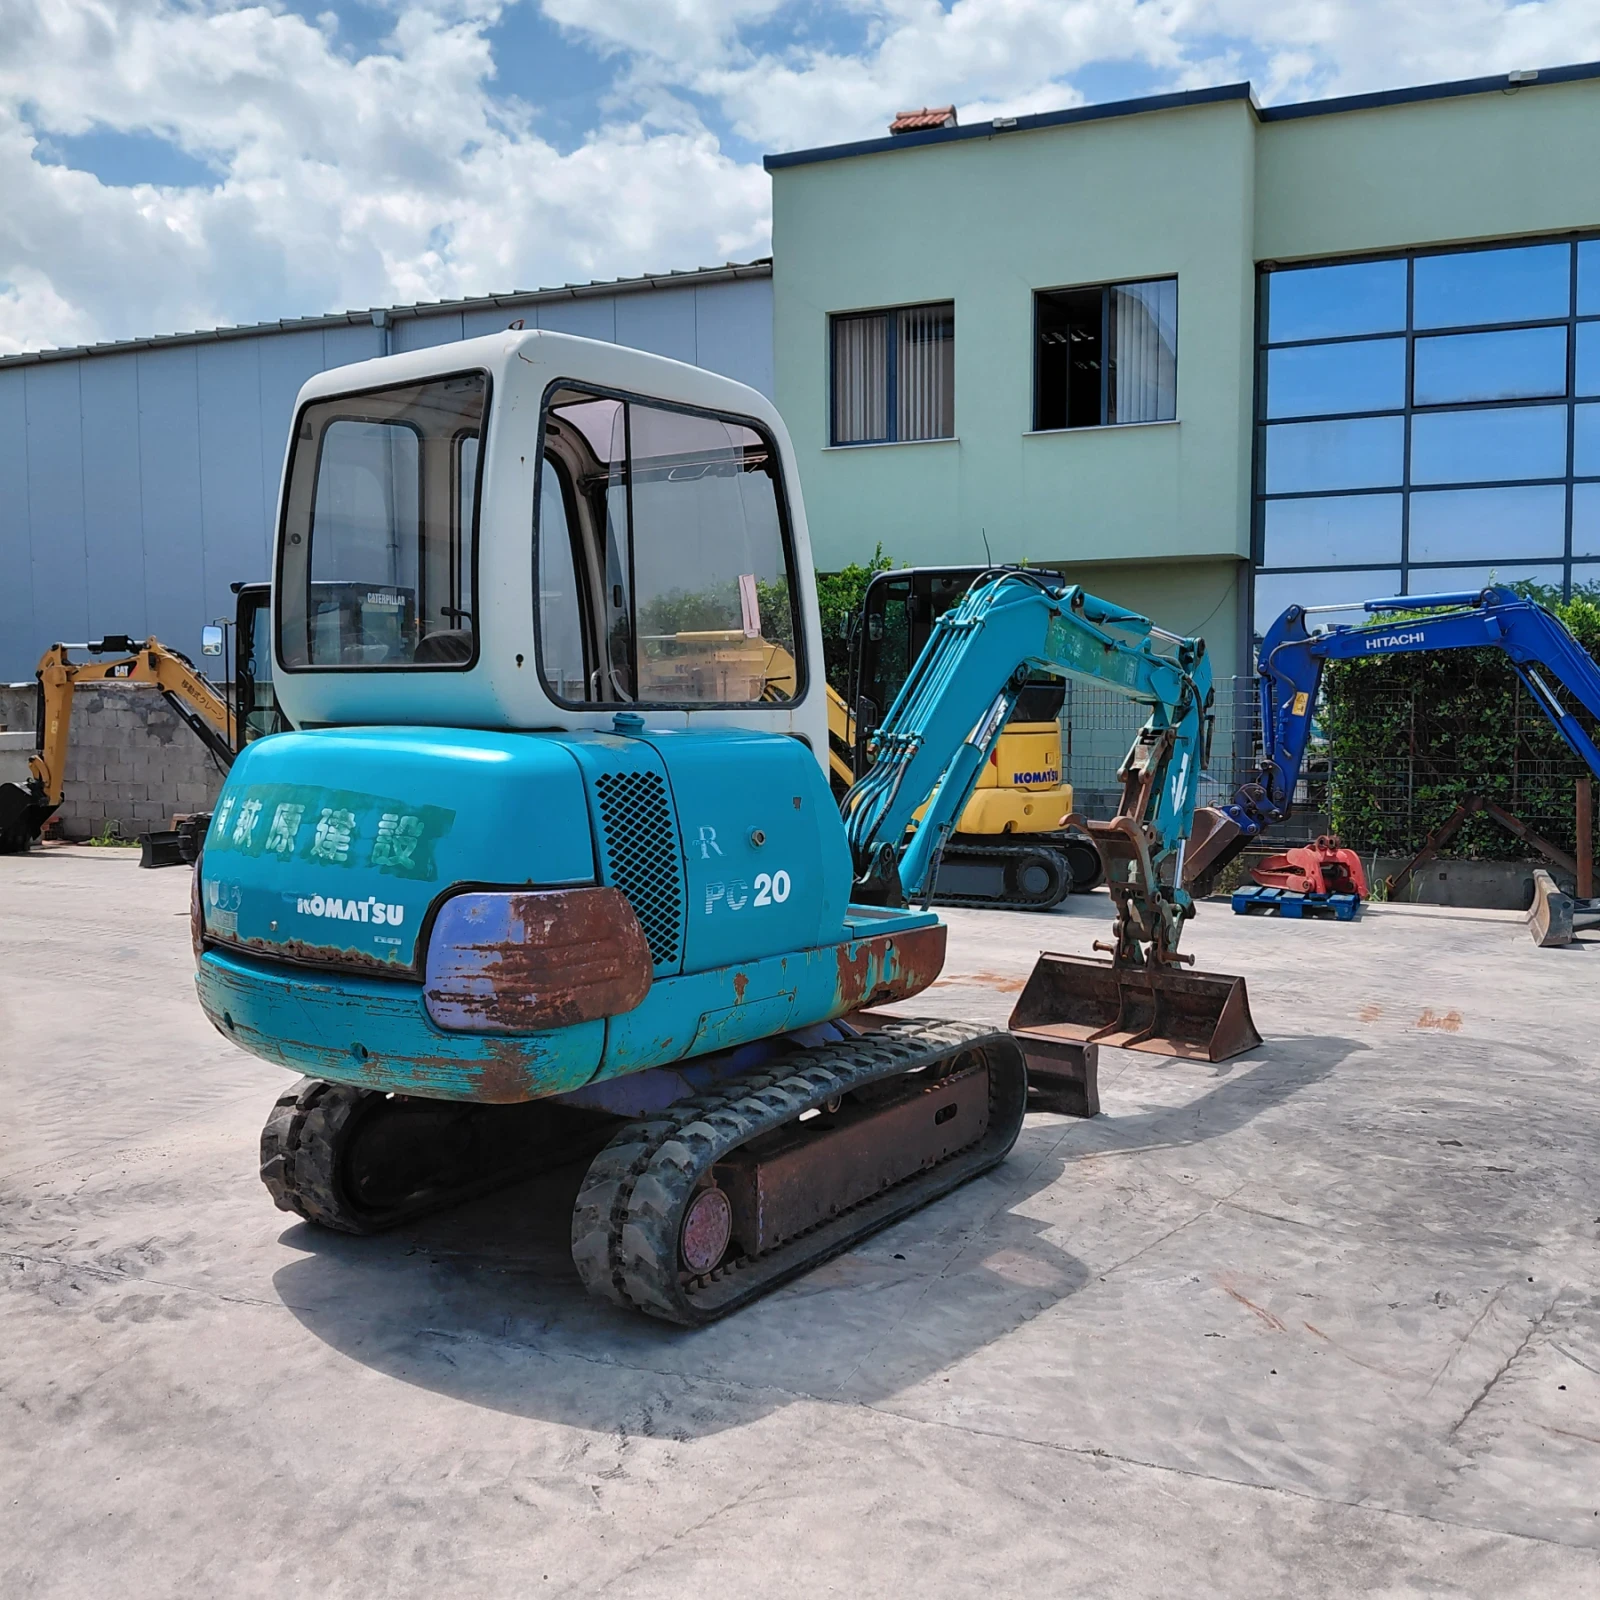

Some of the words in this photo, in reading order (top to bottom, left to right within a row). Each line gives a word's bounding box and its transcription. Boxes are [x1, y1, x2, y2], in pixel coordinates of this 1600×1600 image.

[367, 592, 406, 606] CATERPILLAR
[1365, 632, 1425, 650] HITACHI
[114, 665, 129, 677] CAT
[1013, 768, 1059, 784] KOMATSU
[297, 895, 404, 926] KOMATSU
